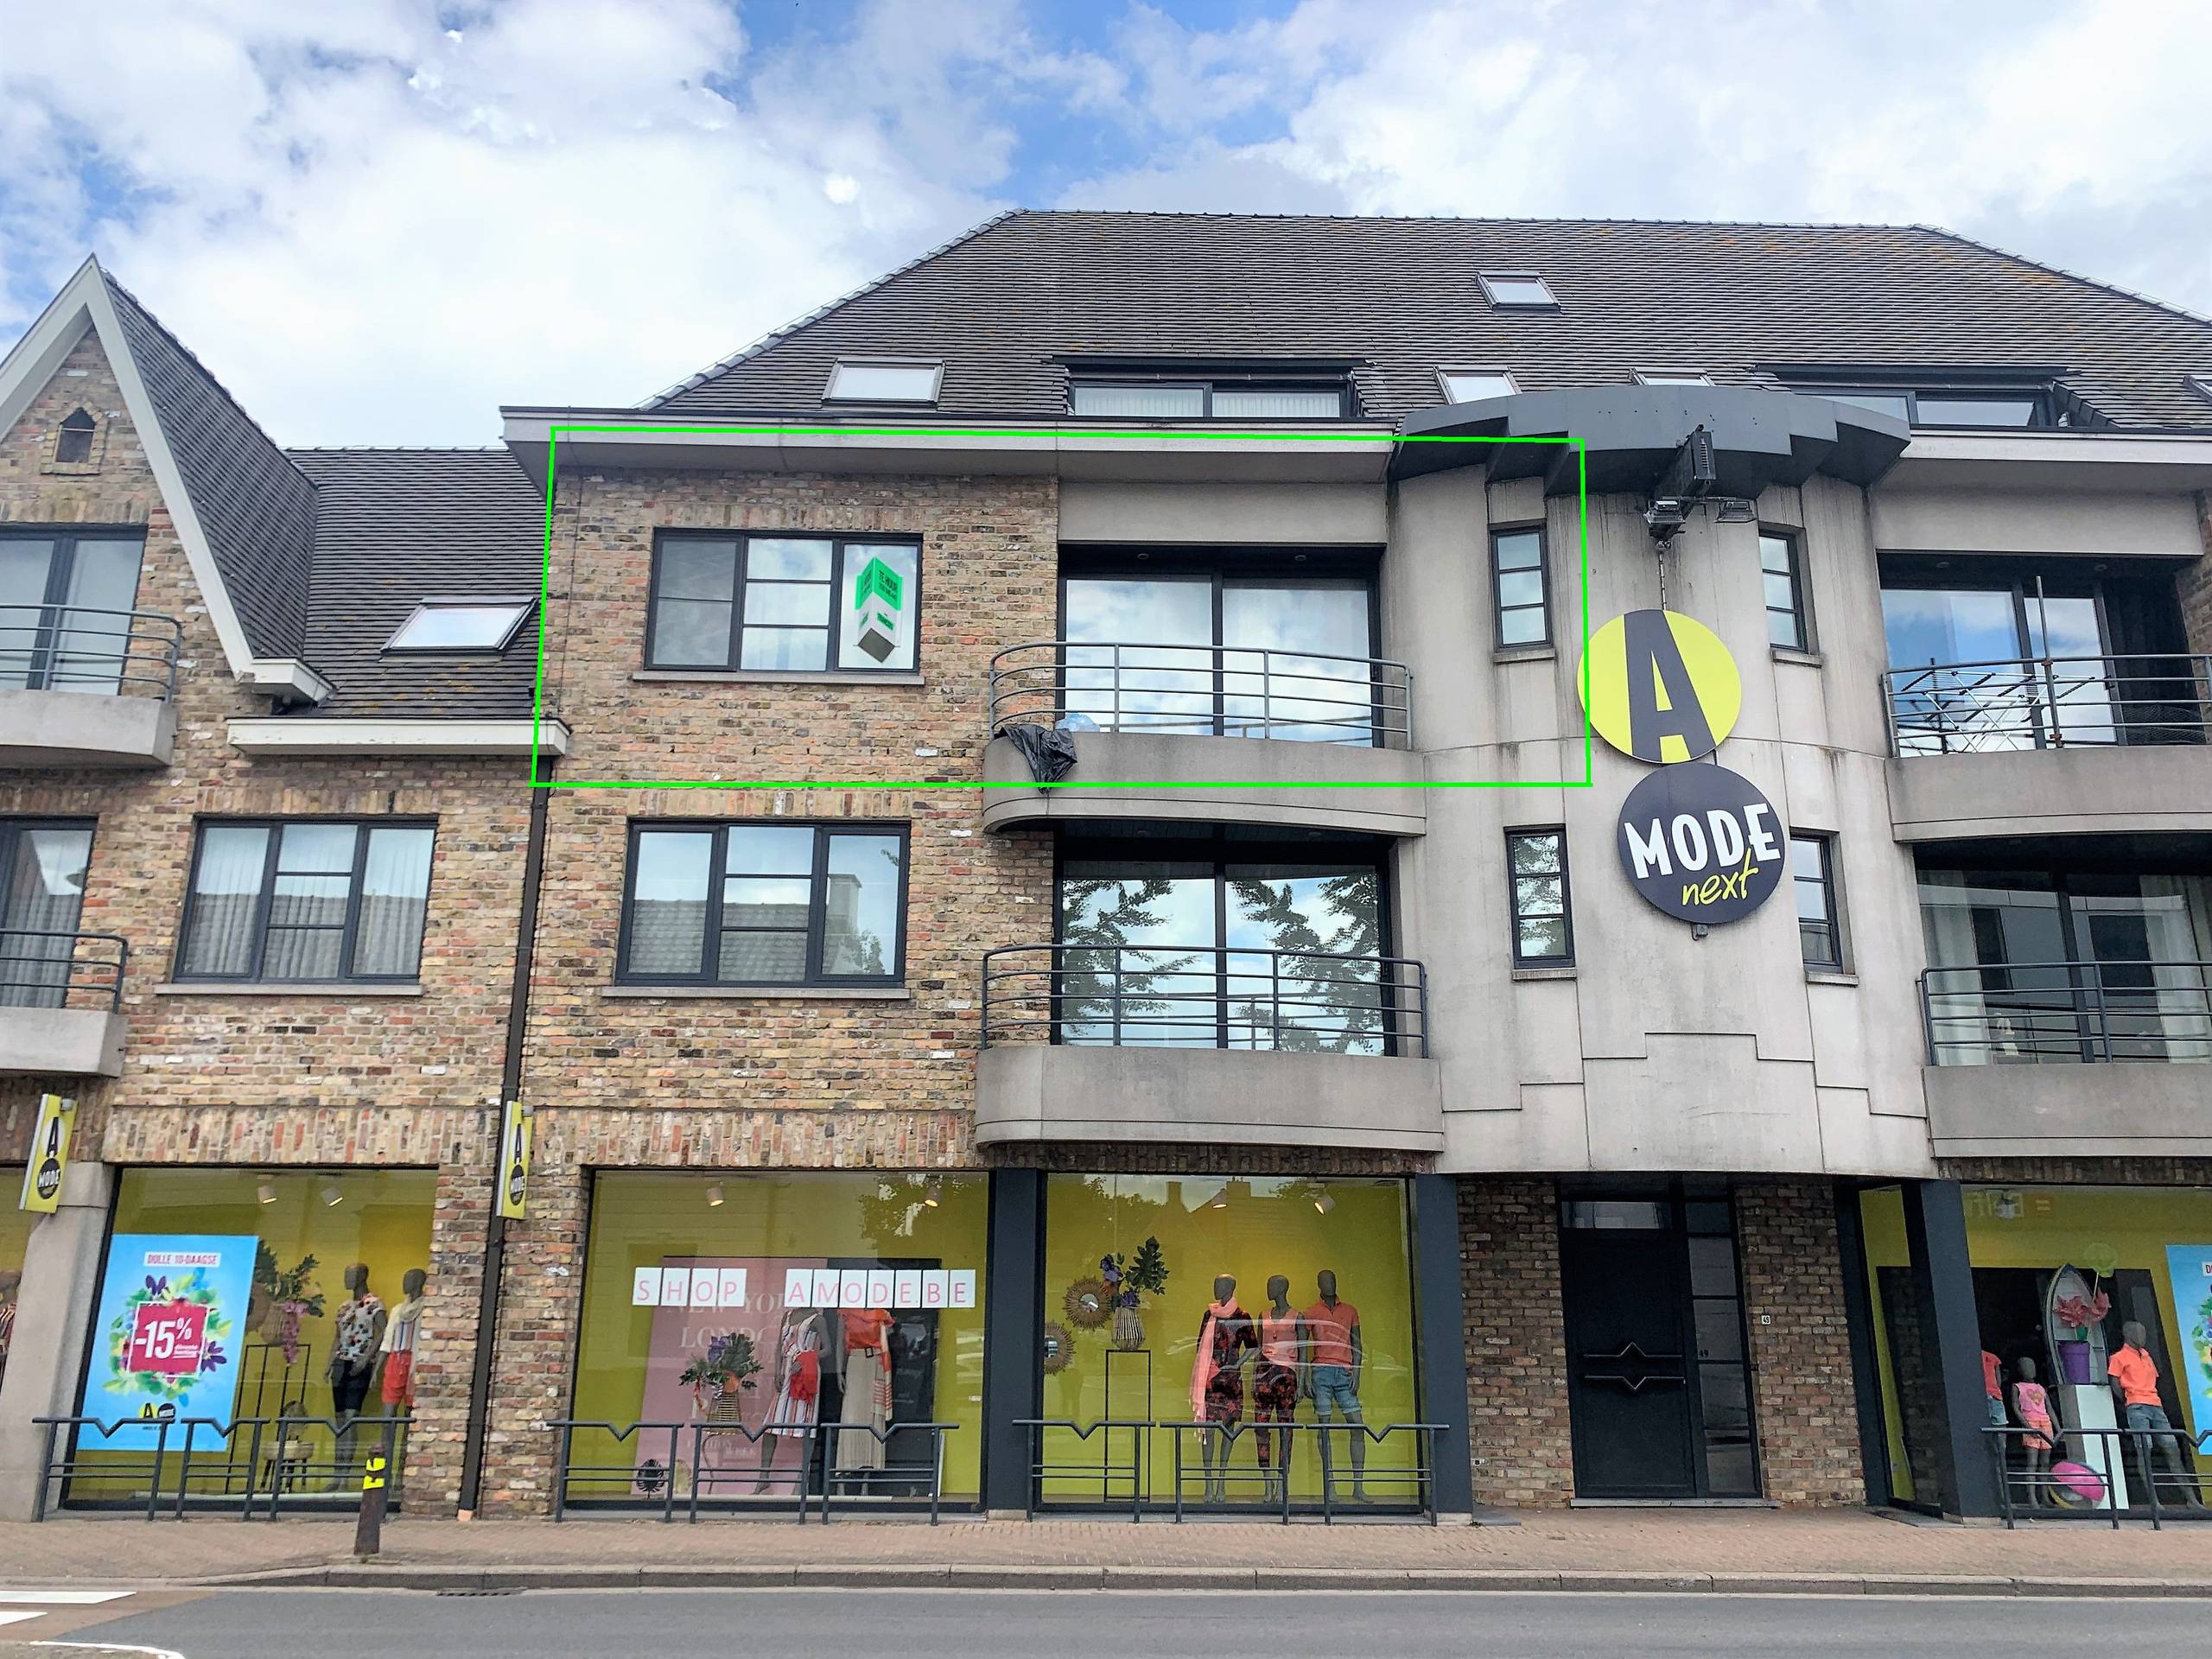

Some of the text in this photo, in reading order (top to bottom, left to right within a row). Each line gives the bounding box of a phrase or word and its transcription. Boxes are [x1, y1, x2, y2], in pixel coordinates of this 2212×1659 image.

[1624, 608, 1717, 763] A
[1624, 803, 1782, 880] MODE
[1681, 849, 1759, 906] next
[47, 1117, 59, 1157] A
[38, 1169, 60, 1188] MODE
[637, 1280, 737, 1302] SHOP
[135, 1318, 192, 1358] -15%
